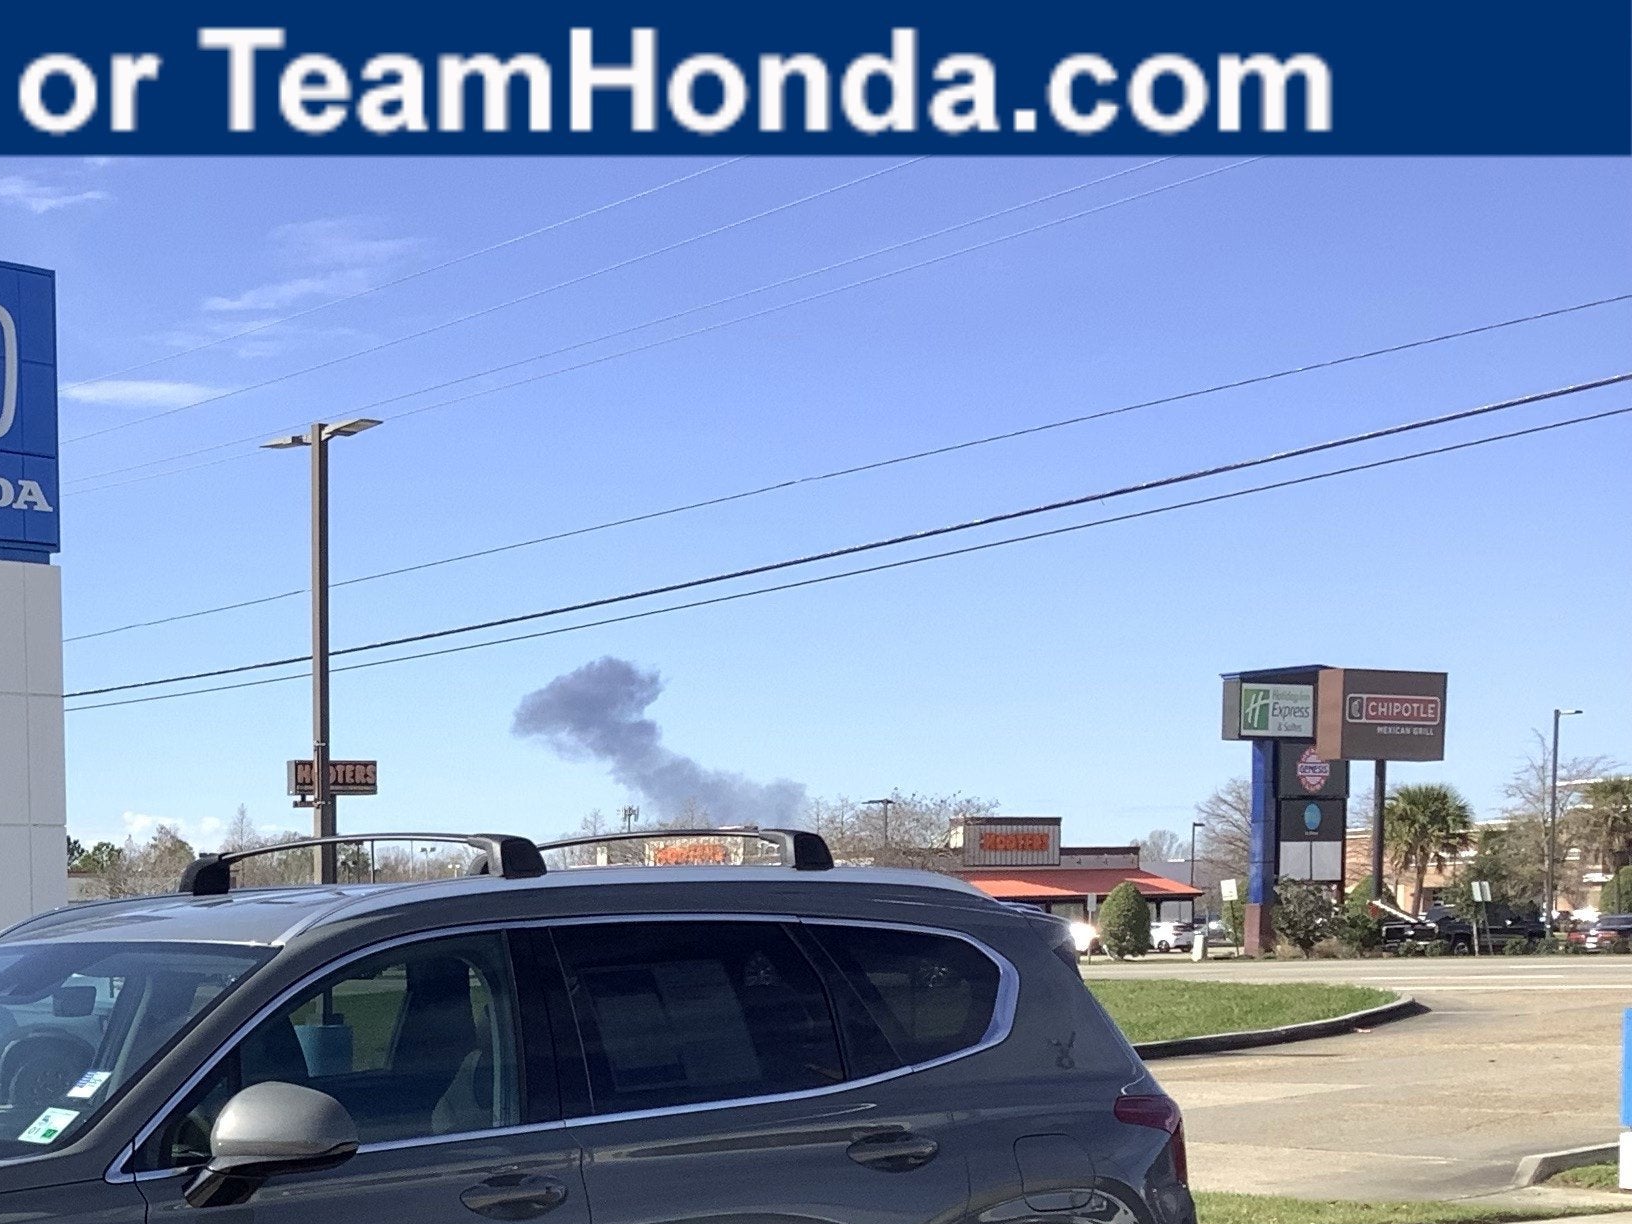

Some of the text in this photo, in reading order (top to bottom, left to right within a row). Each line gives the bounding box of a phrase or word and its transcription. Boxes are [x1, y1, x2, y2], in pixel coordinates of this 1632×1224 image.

[1271, 701, 1310, 718] Express
[1368, 701, 1436, 718] CHIPOTLE
[1376, 726, 1434, 736] MEXICAN GRILL
